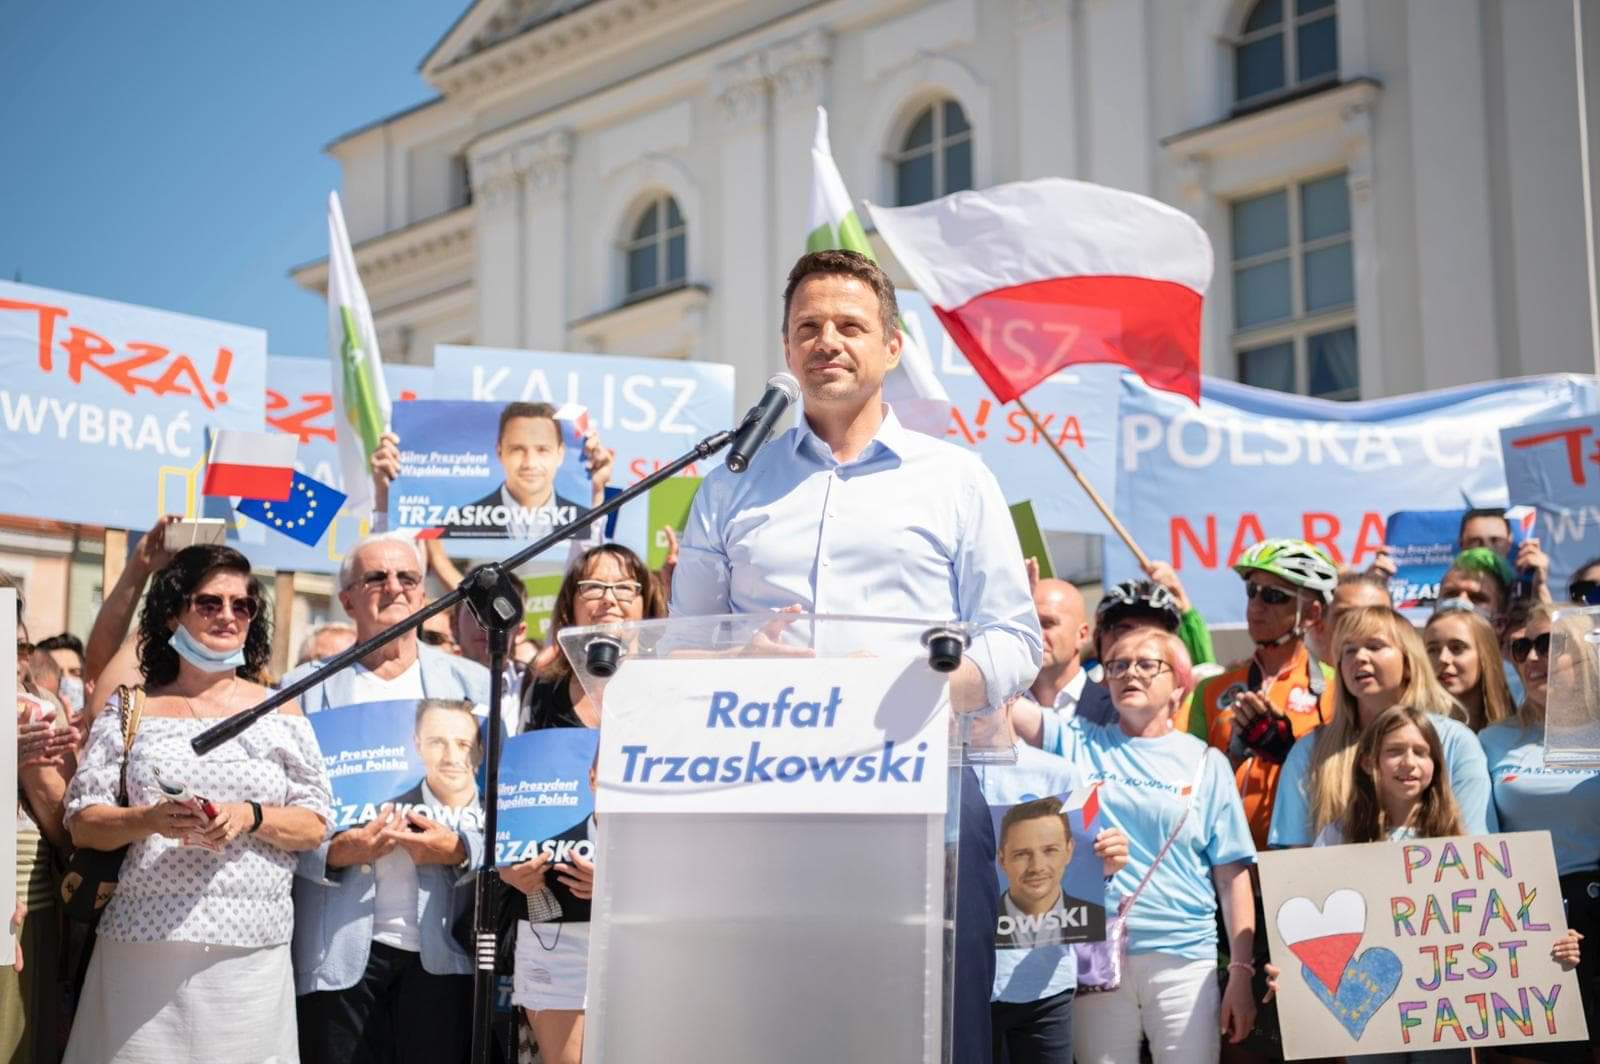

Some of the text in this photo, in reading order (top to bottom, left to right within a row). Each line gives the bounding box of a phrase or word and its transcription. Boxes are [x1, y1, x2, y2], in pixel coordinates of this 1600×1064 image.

[0, 299, 233, 411] TRZA!
[1, 391, 192, 458] WYBRAĆ
[1121, 408, 1402, 473] POLSKA
[398, 504, 578, 527] TRZASKOWSKI
[705, 685, 844, 729] Rafał
[620, 740, 929, 784] Trzaskowski
[1402, 840, 1513, 884] PAN
[1390, 881, 1551, 937] RAFAŁ
[1416, 940, 1528, 992] JEST
[1398, 984, 1562, 1044] FAJNY
